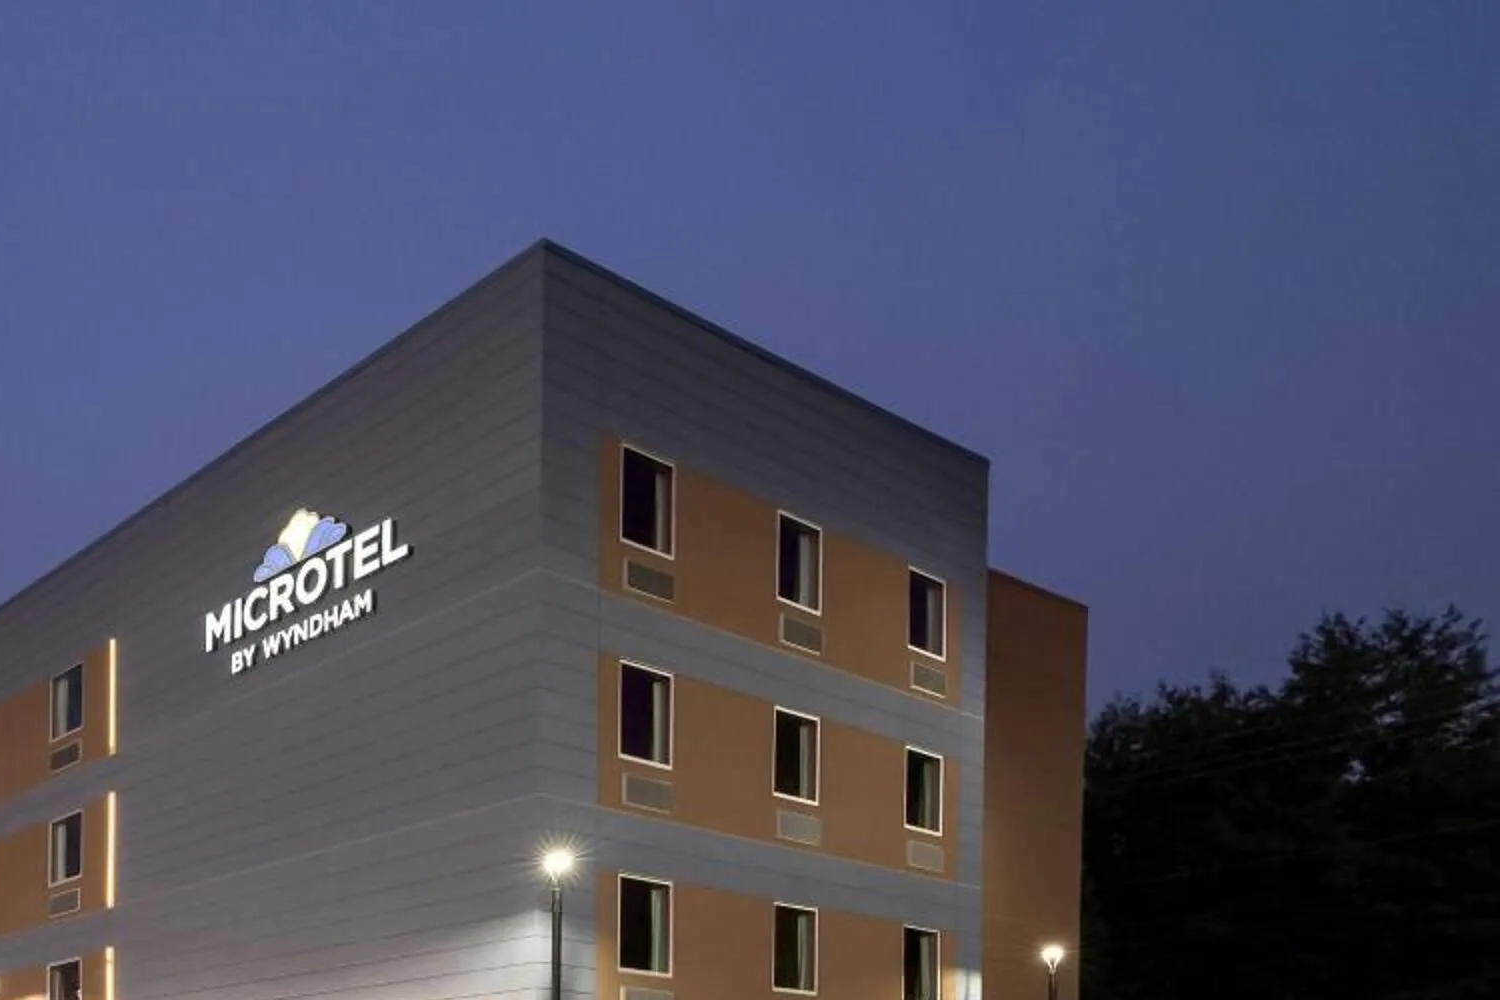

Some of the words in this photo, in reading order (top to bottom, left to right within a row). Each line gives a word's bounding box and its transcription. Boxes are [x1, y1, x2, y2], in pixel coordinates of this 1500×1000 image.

[205, 517, 409, 653] MICROTEL
[231, 644, 256, 675] BY
[262, 588, 373, 659] WYNDHAM
